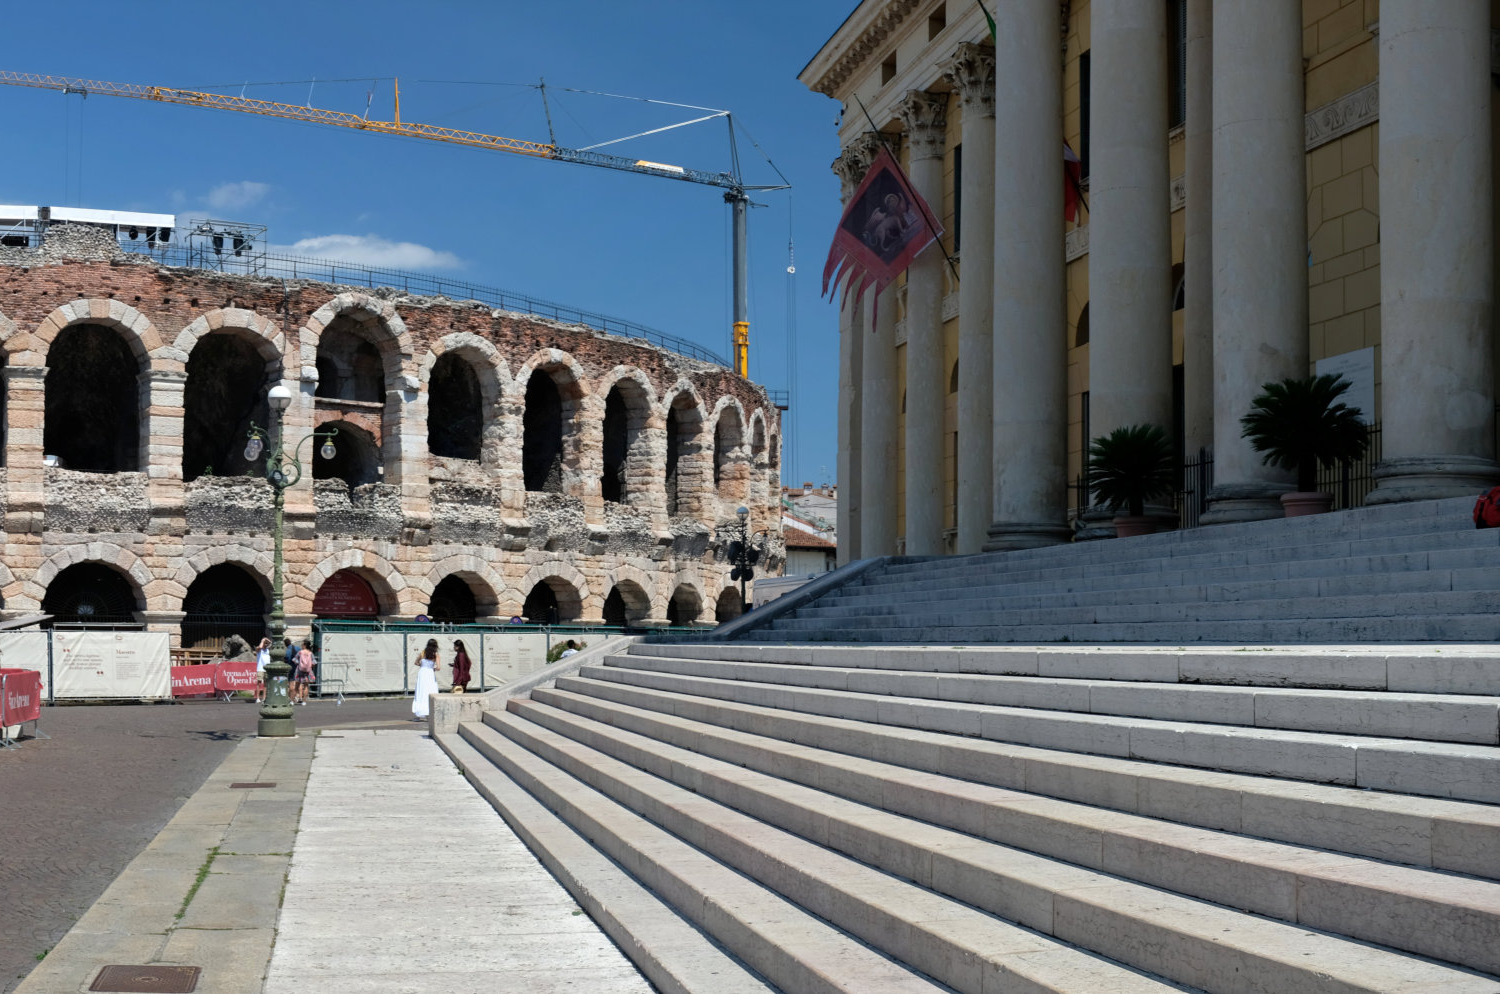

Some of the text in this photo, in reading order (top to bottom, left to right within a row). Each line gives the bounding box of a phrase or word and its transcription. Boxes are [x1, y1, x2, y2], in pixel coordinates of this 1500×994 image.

[222, 669, 241, 677] Arena
[171, 675, 211, 688] inArena
[227, 676, 248, 686] Opera
